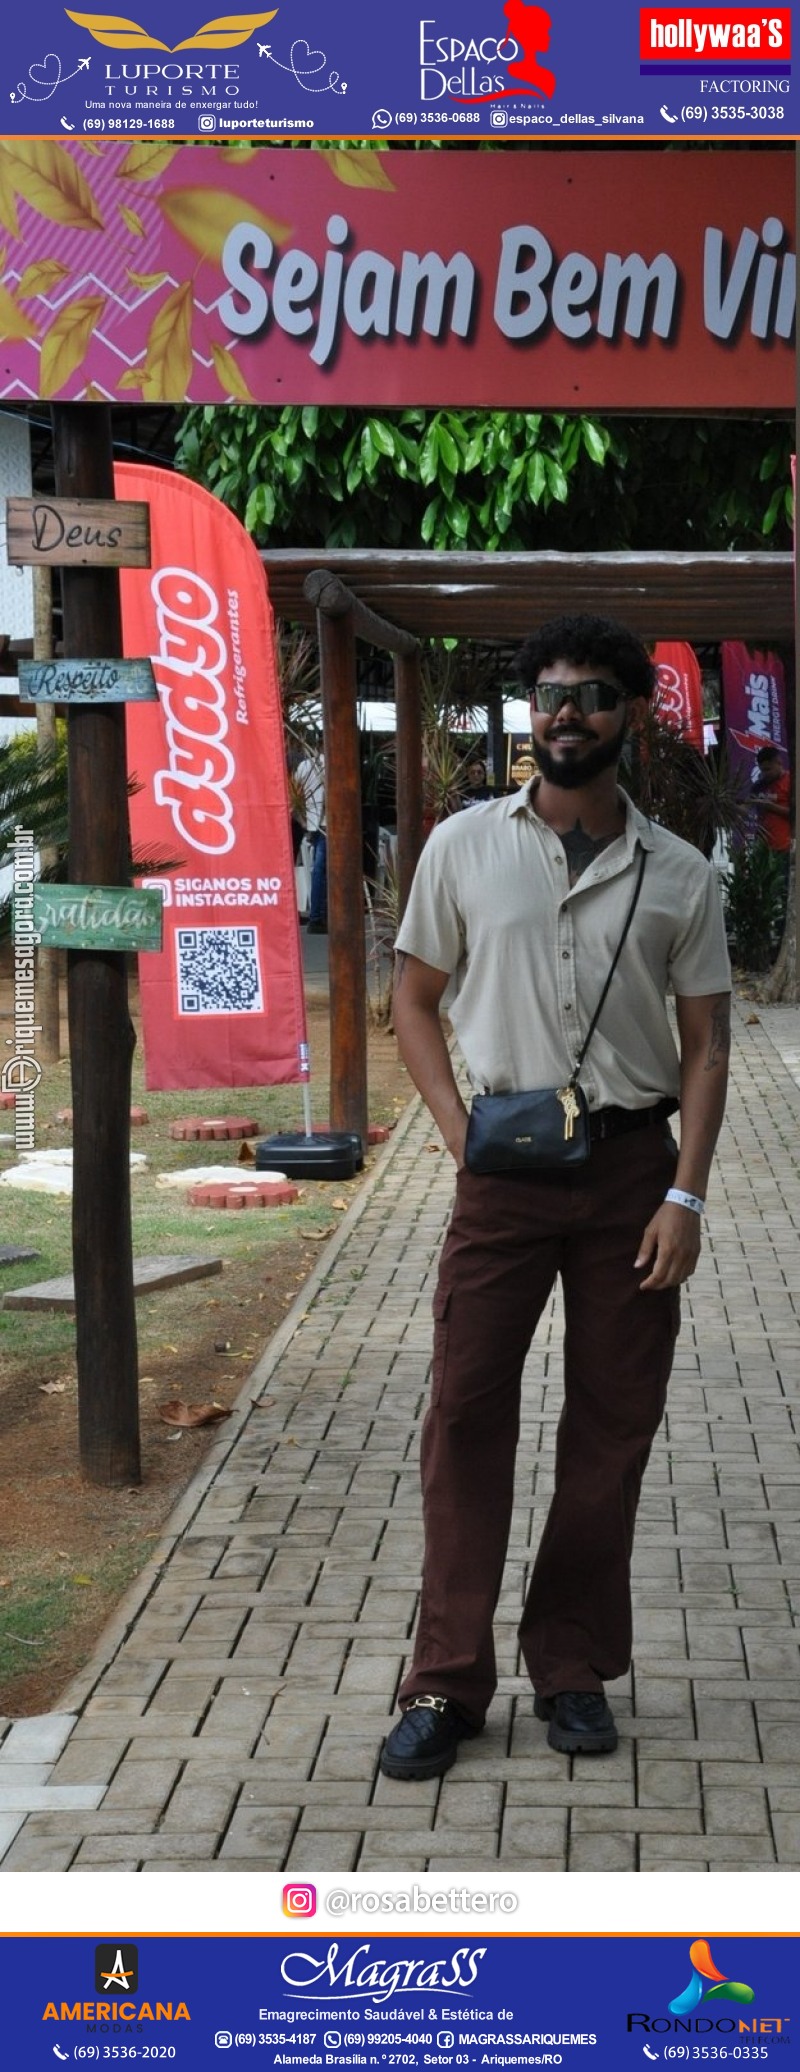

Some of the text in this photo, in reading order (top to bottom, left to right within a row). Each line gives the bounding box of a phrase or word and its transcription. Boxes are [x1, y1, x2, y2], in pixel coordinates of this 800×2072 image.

[217, 214, 475, 366] Sejam
[494, 224, 678, 340] Bem
[32, 504, 123, 552] Deus
[27, 661, 121, 698] Respeito
[226, 588, 249, 725] Refrigerantes
[149, 566, 236, 855] dydyo
[174, 878, 281, 891] SIGANOS NO
[175, 893, 278, 907] INSTAGRAM
